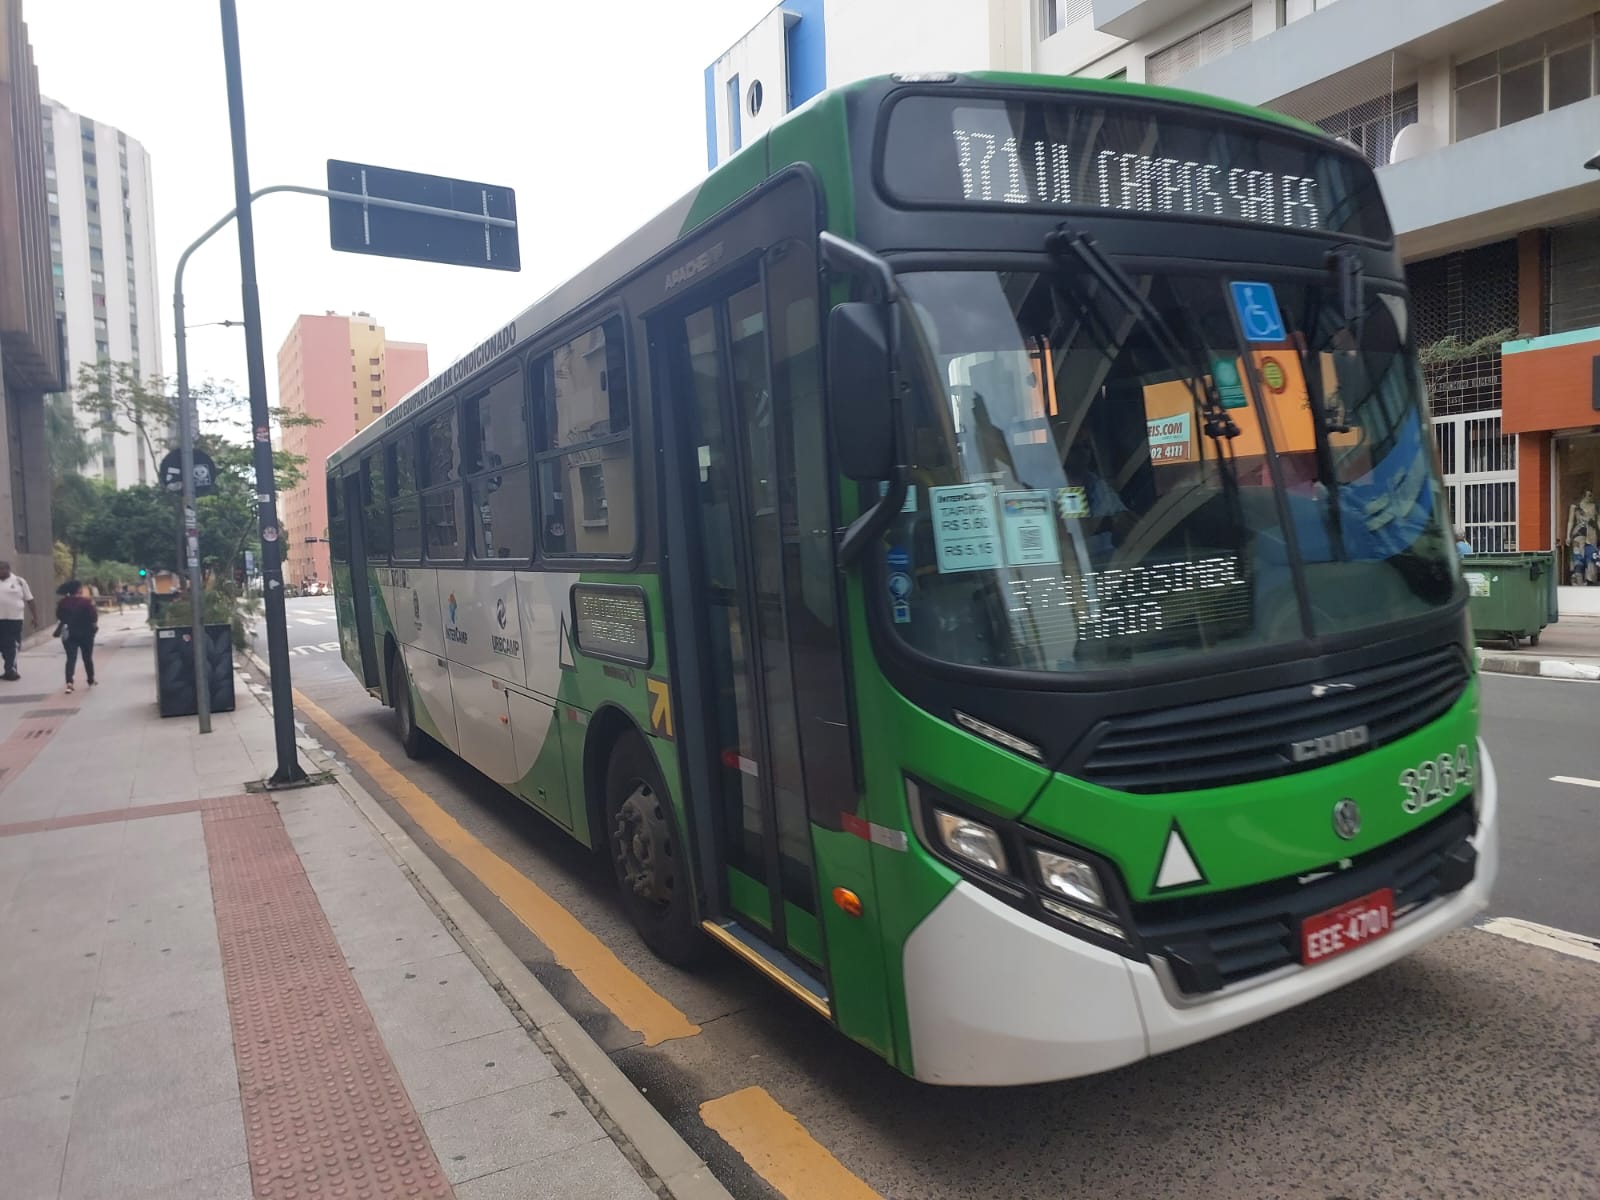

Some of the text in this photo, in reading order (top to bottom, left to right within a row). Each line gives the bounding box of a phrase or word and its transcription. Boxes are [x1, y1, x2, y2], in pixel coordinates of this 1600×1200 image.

[442, 364, 453, 389] AR
[453, 321, 517, 381] CONDICIONADO
[1399, 743, 1473, 814] 3264
